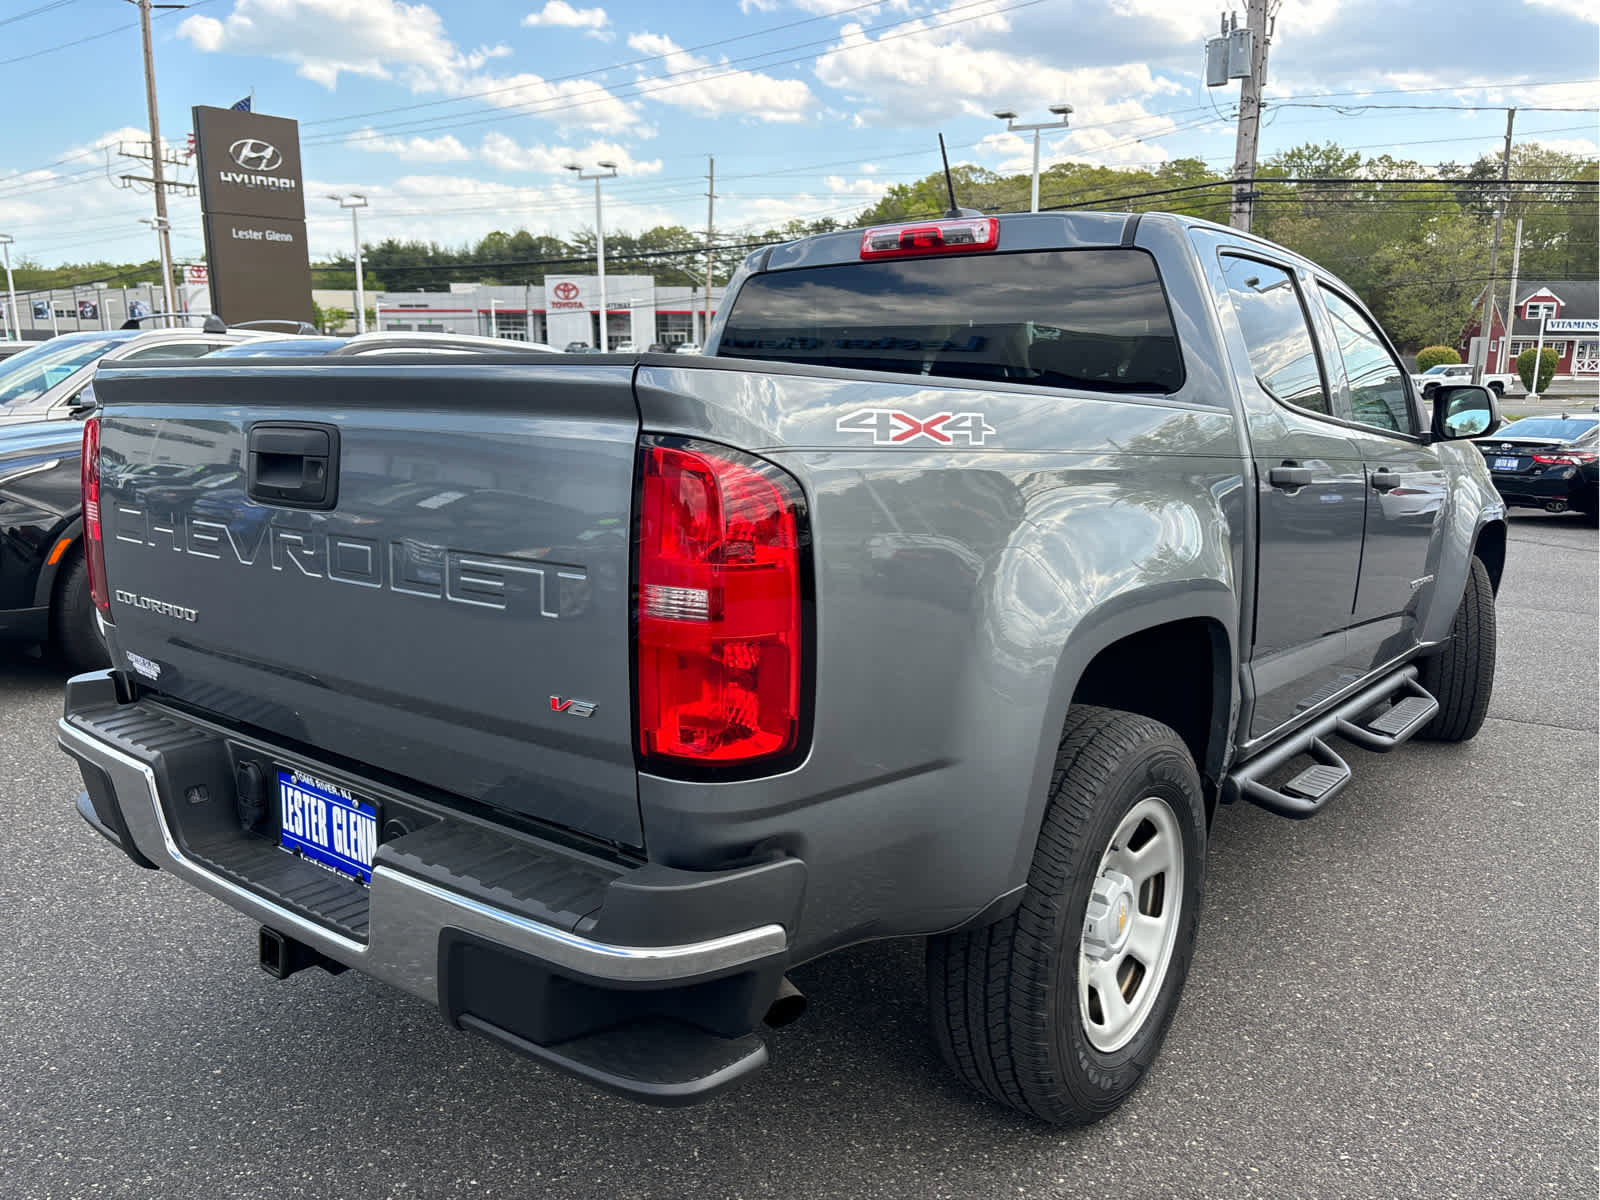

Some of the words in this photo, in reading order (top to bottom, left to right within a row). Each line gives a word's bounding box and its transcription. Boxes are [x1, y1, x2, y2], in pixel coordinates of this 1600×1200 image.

[220, 171, 296, 189] HYUNDAI
[232, 228, 263, 241] Lester
[265, 230, 293, 243] Glenn
[551, 301, 584, 309] TOYOTA
[1550, 320, 1598, 330] VITAMINS
[113, 502, 587, 618] CHEVROLET
[115, 590, 199, 622] COLORADO
[550, 696, 597, 718] V6
[340, 789, 352, 801] NJ
[281, 784, 329, 848] LESTER
[332, 805, 377, 868] GLENN
